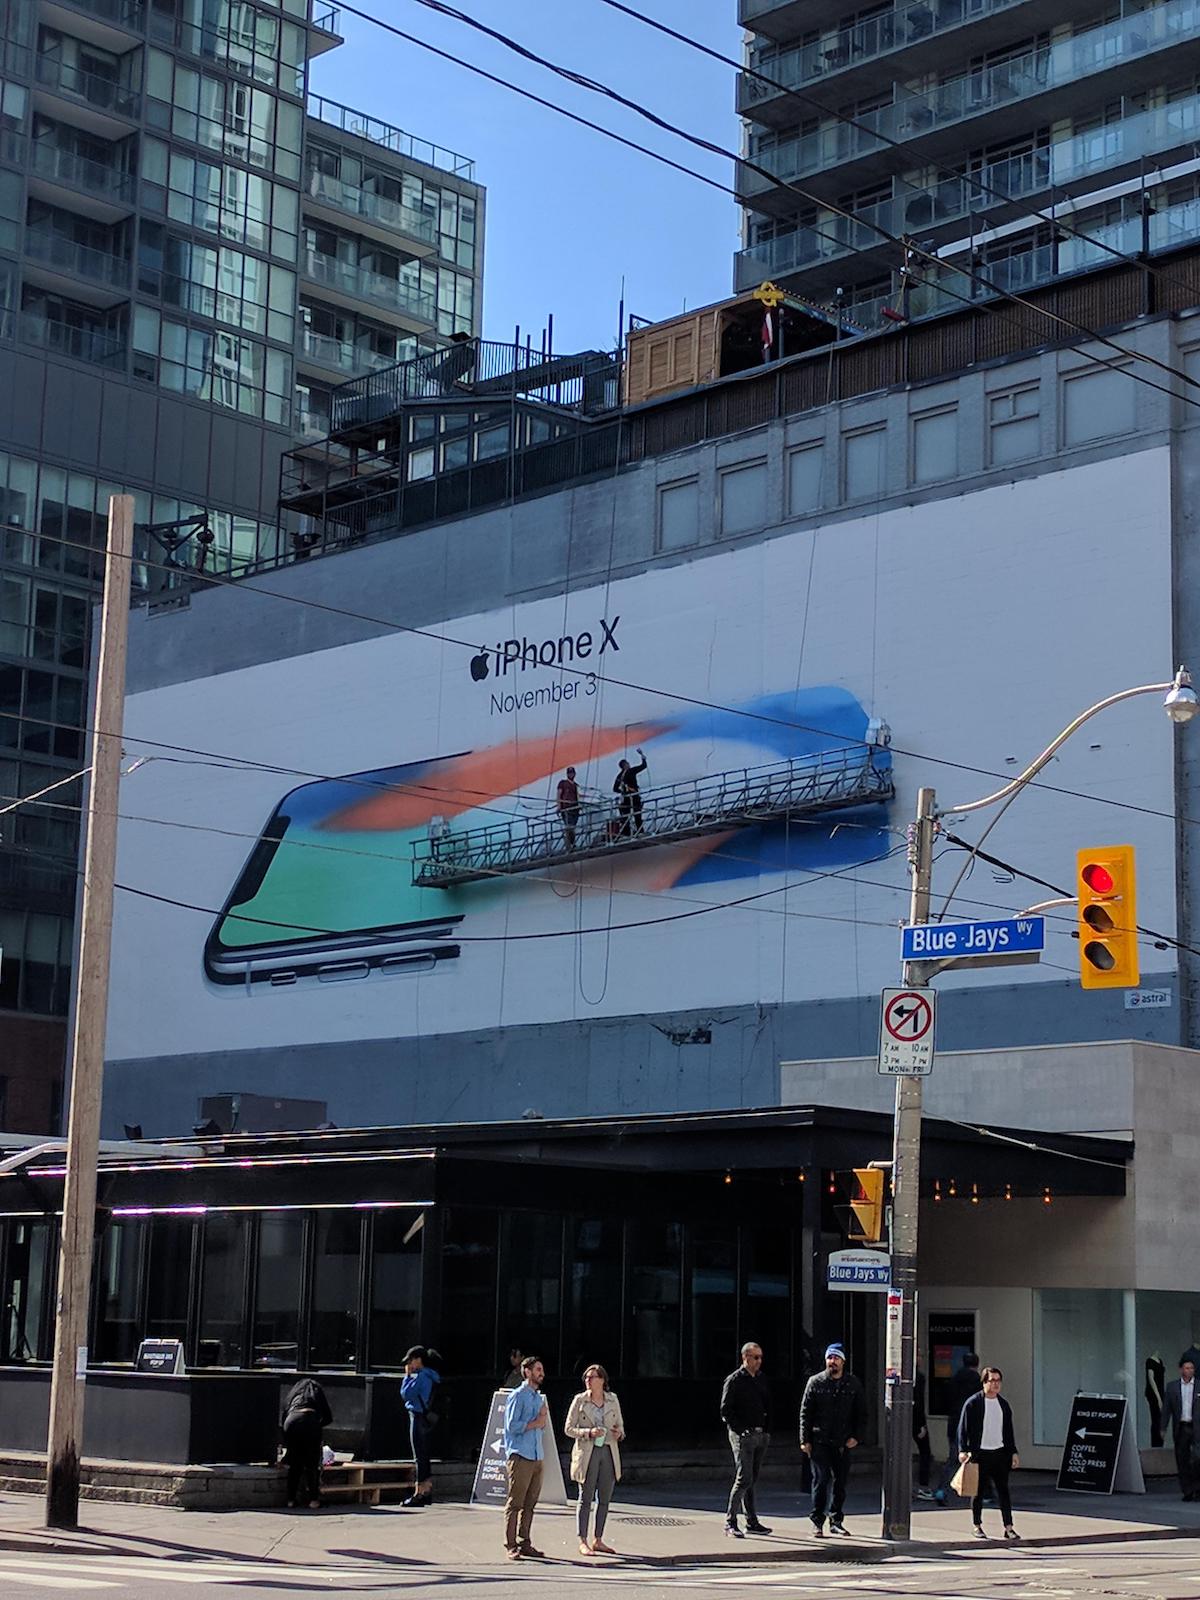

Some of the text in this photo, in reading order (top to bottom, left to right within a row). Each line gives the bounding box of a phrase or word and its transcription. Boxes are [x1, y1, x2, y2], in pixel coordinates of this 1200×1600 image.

[495, 616, 620, 677] iPhone X
[490, 672, 597, 715] November 3
[912, 921, 1033, 952] Blue Jays Wy
[1142, 993, 1167, 1003] astral
[884, 1042, 889, 1051] 7
[912, 1043, 919, 1052] 10
[883, 1055, 889, 1064] 3
[912, 1056, 917, 1064] 7
[830, 1266, 851, 1279] Blue
[853, 1266, 875, 1282] Jays
[1068, 1458, 1106, 1468] COLD PRESS
